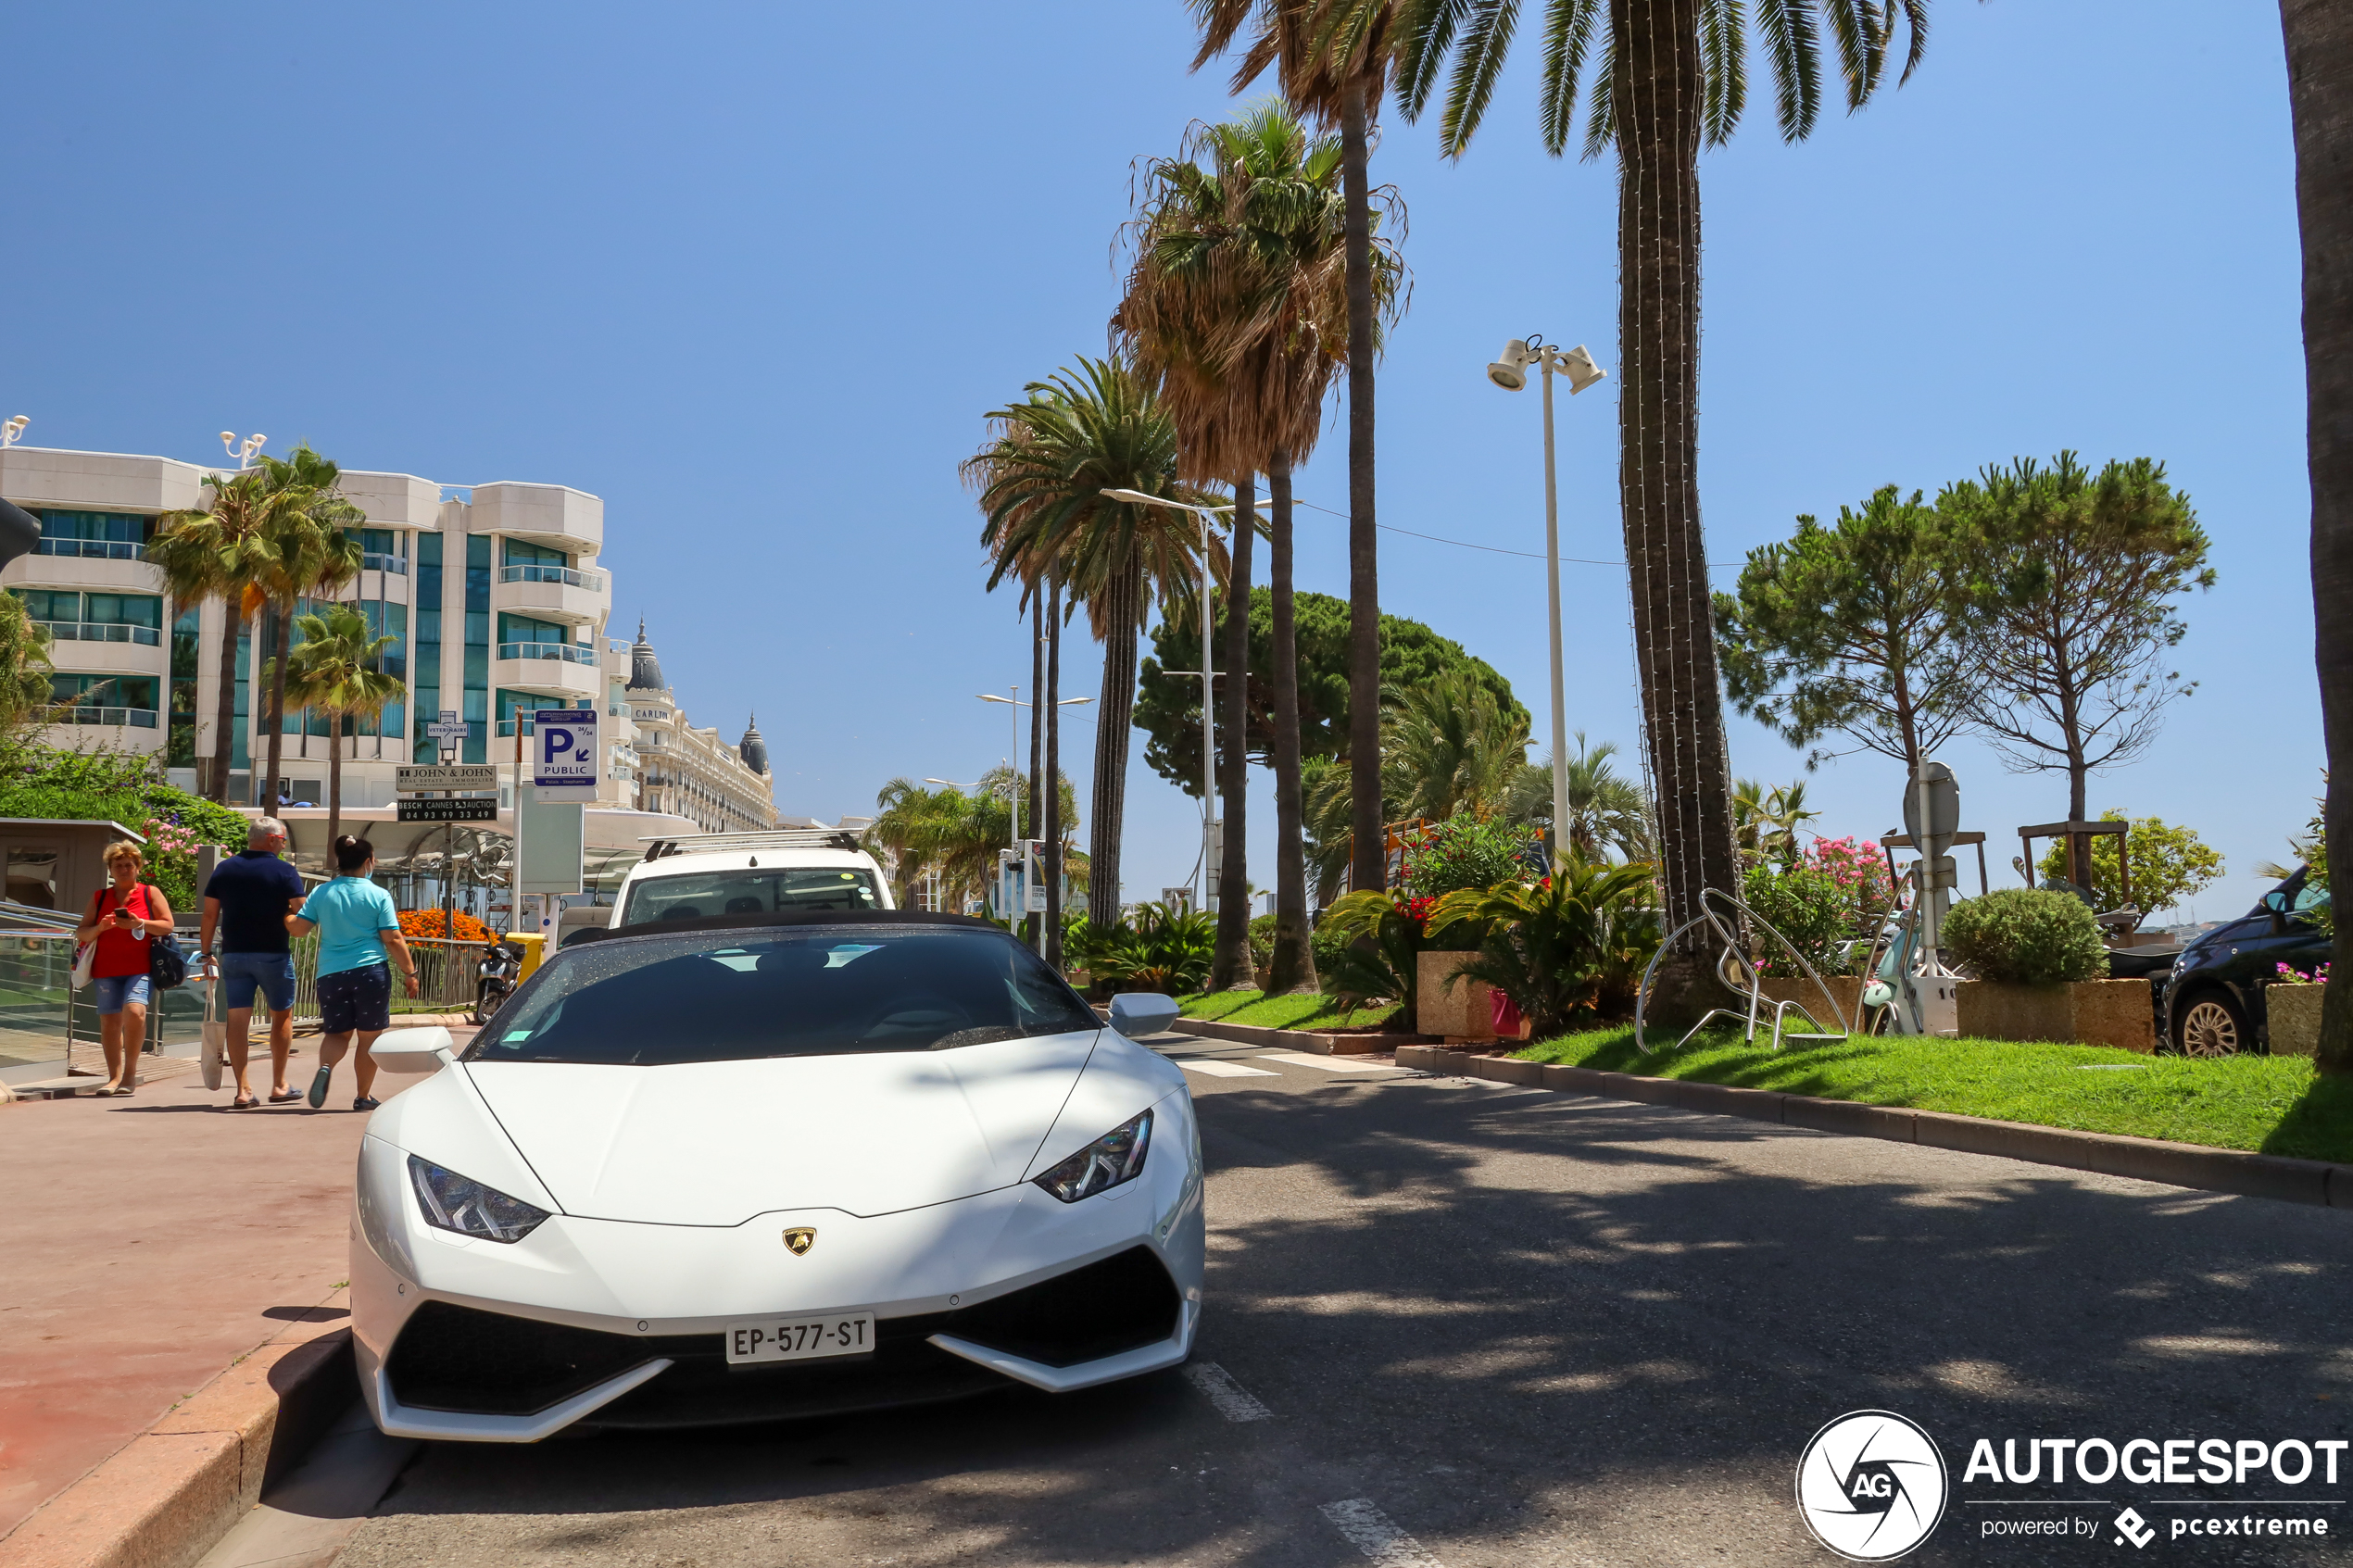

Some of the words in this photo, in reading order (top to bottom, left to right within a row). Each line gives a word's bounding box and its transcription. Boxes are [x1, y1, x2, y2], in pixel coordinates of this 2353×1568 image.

[578, 727, 593, 736] 24/24
[545, 728, 574, 763] P
[413, 769, 447, 778] JOHN
[449, 769, 458, 777] &
[460, 768, 494, 777] JOHN
[545, 766, 587, 774] PUBLIC
[466, 800, 497, 809] AUCTION
[735, 1320, 867, 1355] EP-577-ST
